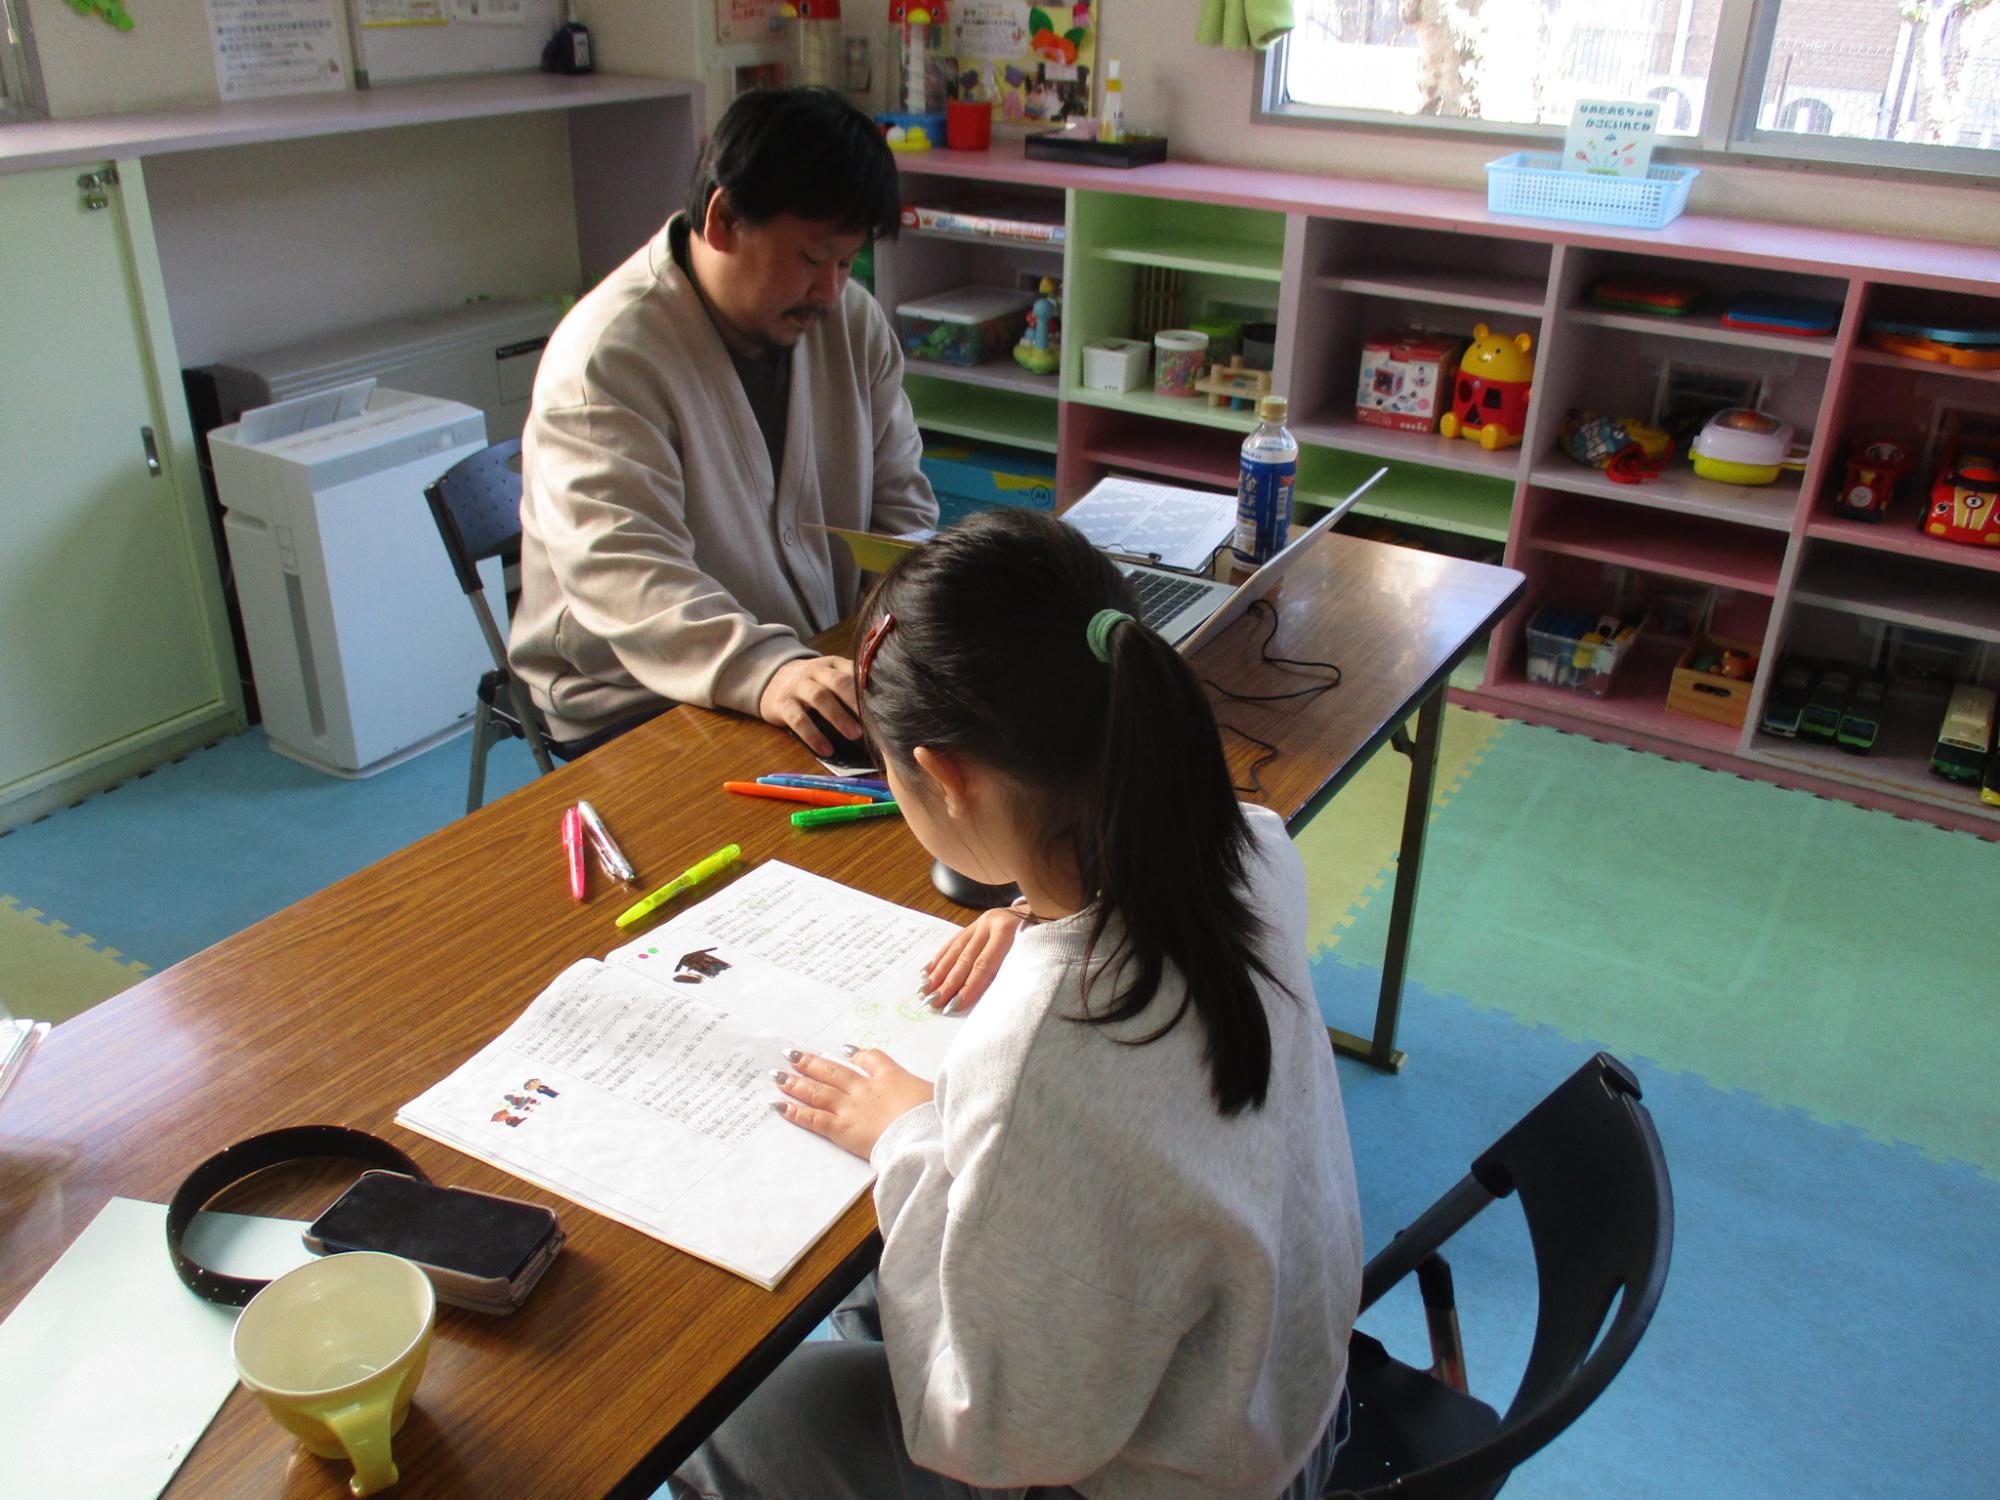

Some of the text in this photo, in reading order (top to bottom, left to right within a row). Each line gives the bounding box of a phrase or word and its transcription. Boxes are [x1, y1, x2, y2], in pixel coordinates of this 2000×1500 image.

[1585, 118, 1651, 131] かごにいれてね
